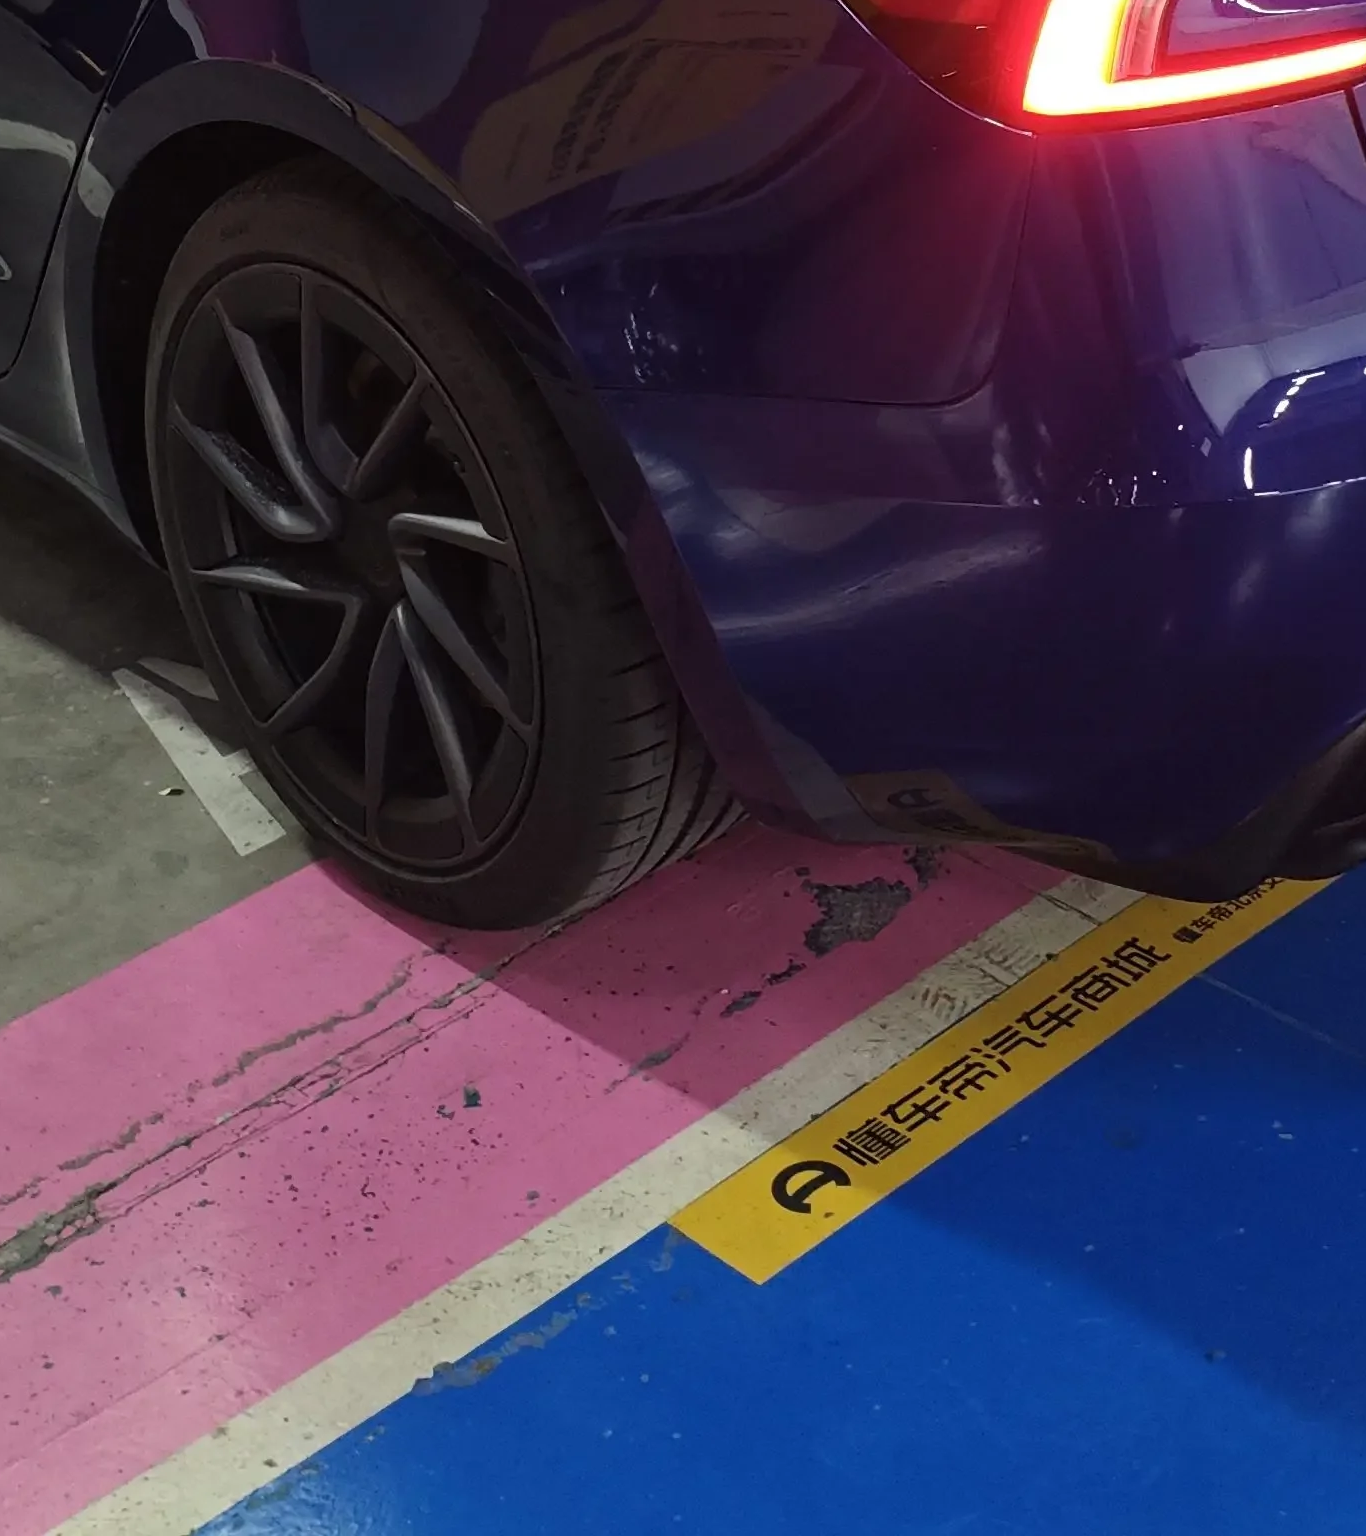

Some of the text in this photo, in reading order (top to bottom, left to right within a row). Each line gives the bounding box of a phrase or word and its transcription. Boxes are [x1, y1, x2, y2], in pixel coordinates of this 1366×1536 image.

[832, 936, 1173, 1167] 懂车帝汽车商城
